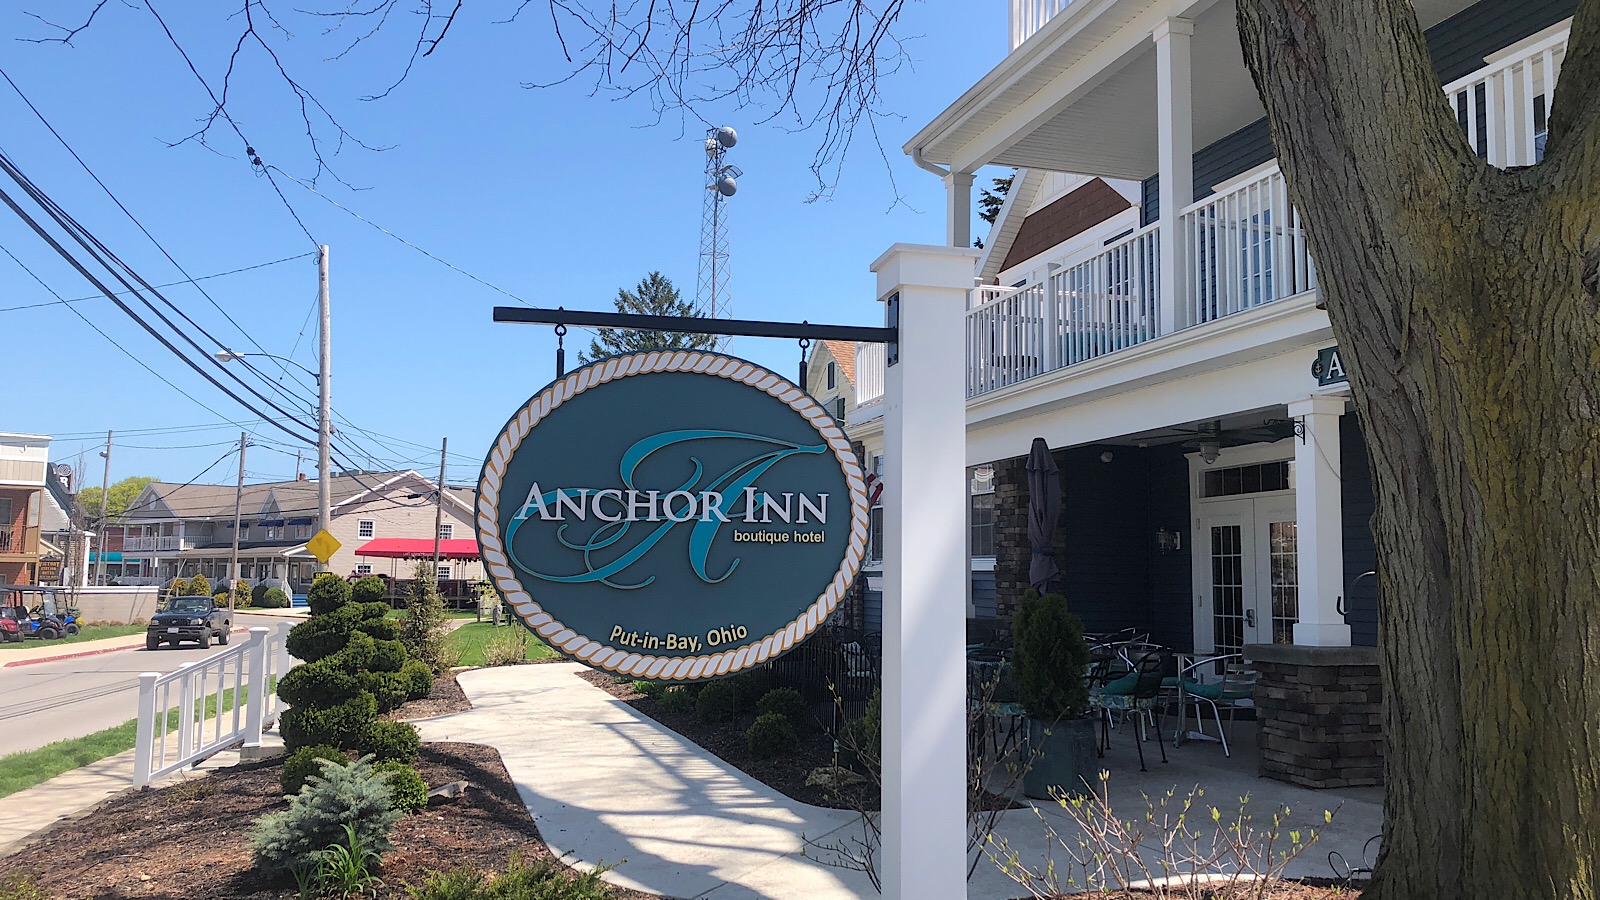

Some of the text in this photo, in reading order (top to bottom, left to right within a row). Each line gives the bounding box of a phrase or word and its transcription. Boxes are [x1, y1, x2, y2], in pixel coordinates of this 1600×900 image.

[513, 481, 830, 525] ANCHOR INN
[734, 529, 825, 545] boutique hotel
[609, 624, 748, 653] Put-in-Bay, Ohio
